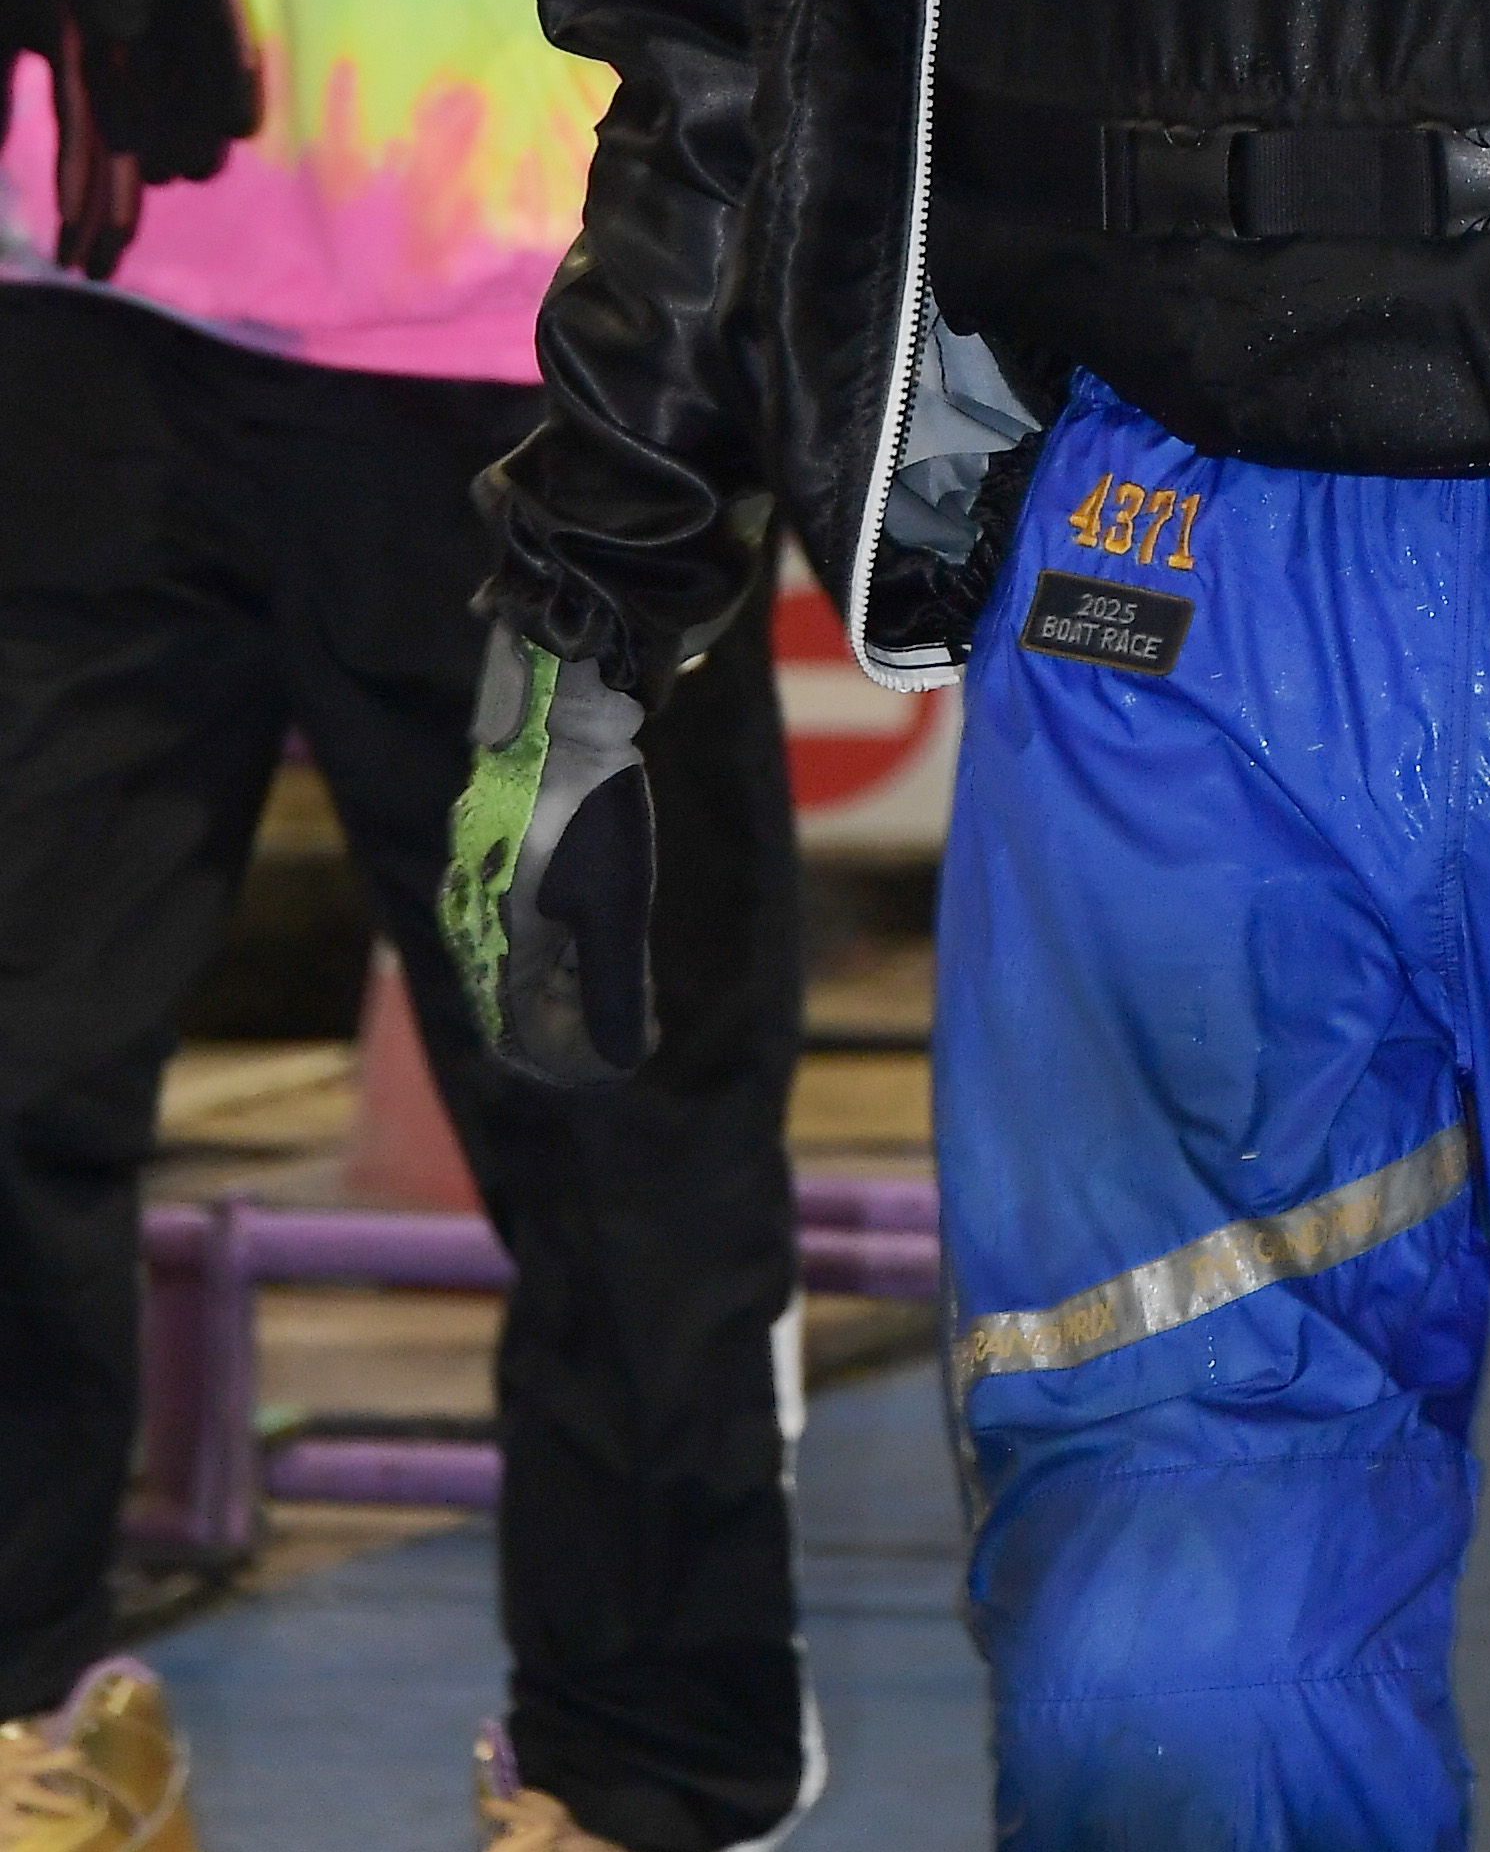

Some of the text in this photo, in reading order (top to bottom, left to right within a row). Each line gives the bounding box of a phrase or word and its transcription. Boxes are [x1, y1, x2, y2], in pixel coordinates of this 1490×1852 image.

[1068, 473, 1201, 570] 4371
[1076, 593, 1139, 625] 2025
[1042, 615, 1163, 660] BOAT RACE
